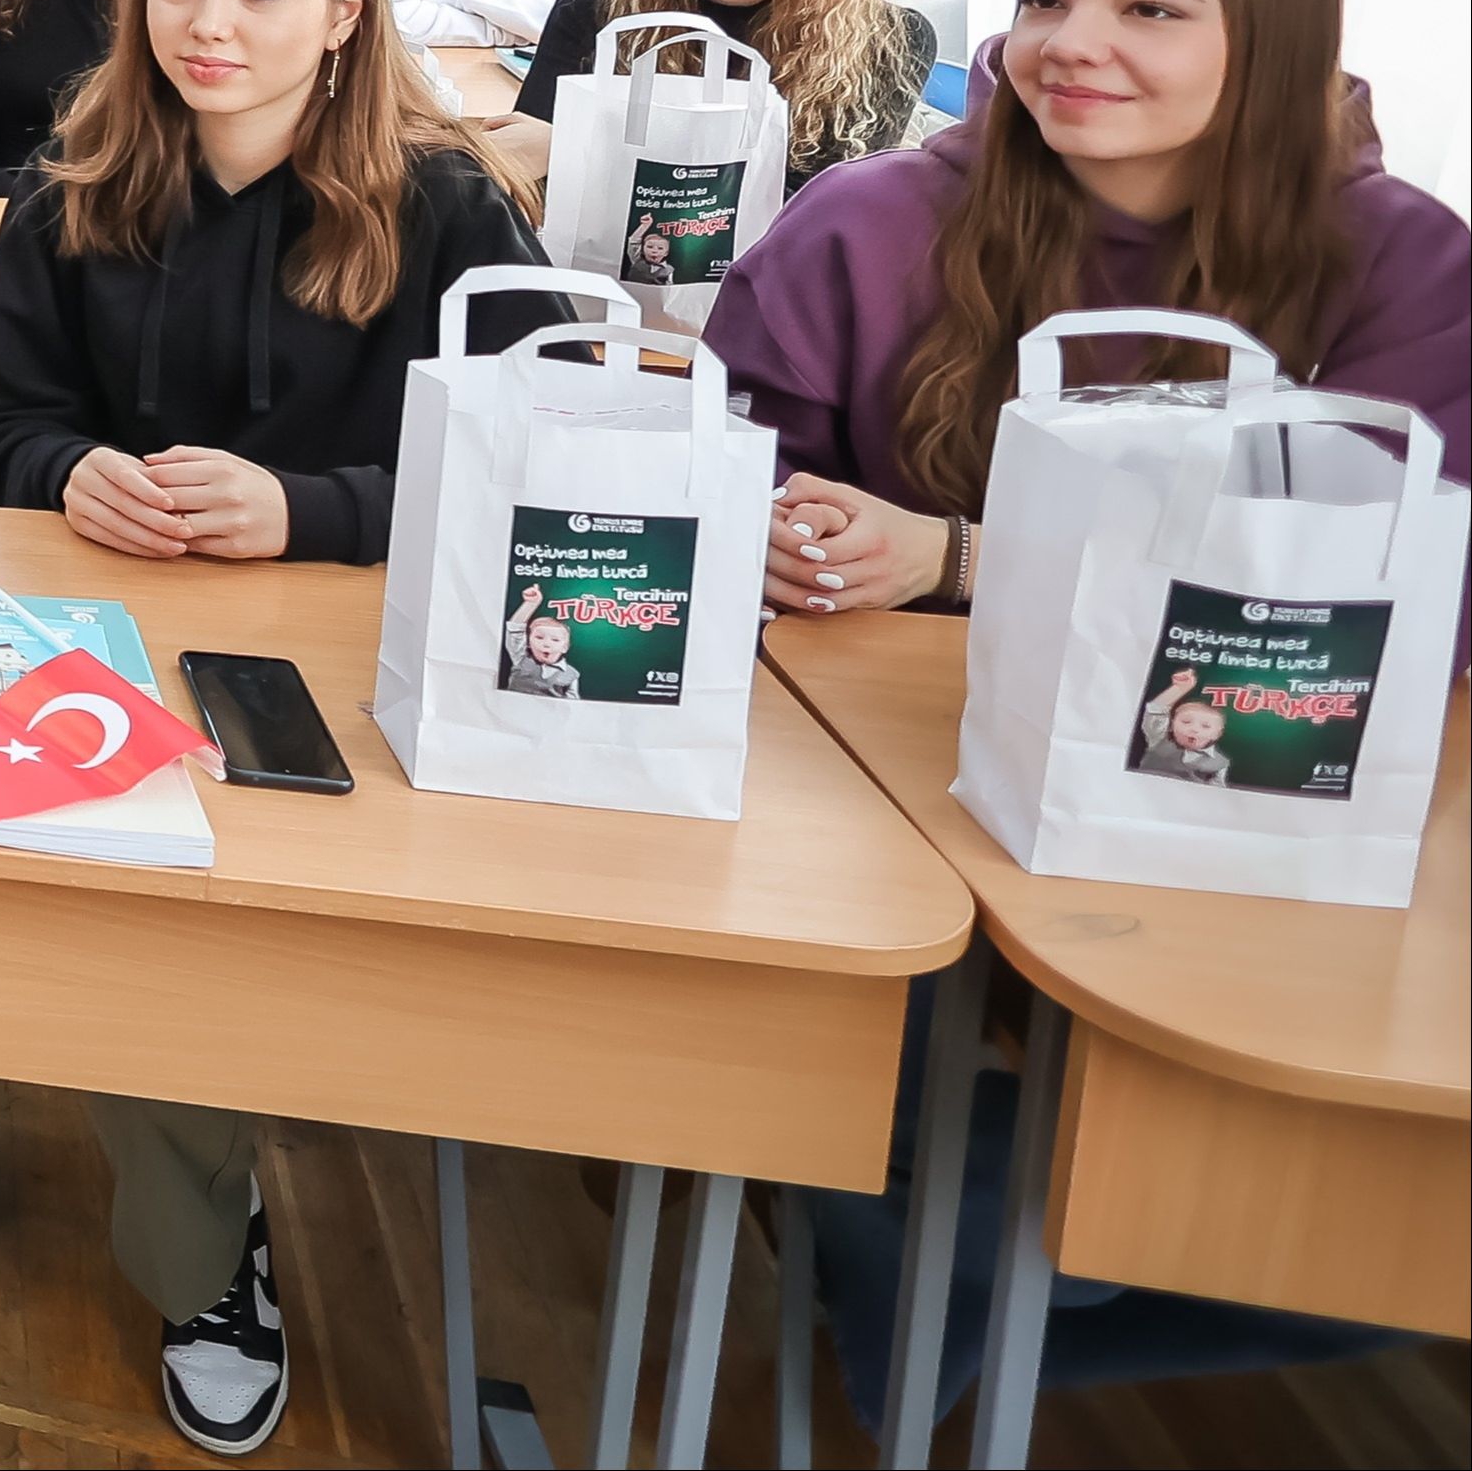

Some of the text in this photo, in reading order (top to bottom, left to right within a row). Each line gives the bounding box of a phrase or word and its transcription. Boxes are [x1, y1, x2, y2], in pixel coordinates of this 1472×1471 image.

[592, 547, 628, 560] mea
[514, 563, 648, 579] este limba turcă
[613, 587, 688, 603] Tercihim
[547, 594, 680, 632] TÜRKÇE
[1266, 637, 1310, 651] mea
[1165, 647, 1330, 670] este limba turcă
[1287, 678, 1370, 693] Tercihim
[1201, 683, 1358, 725] TÜRKÇE
